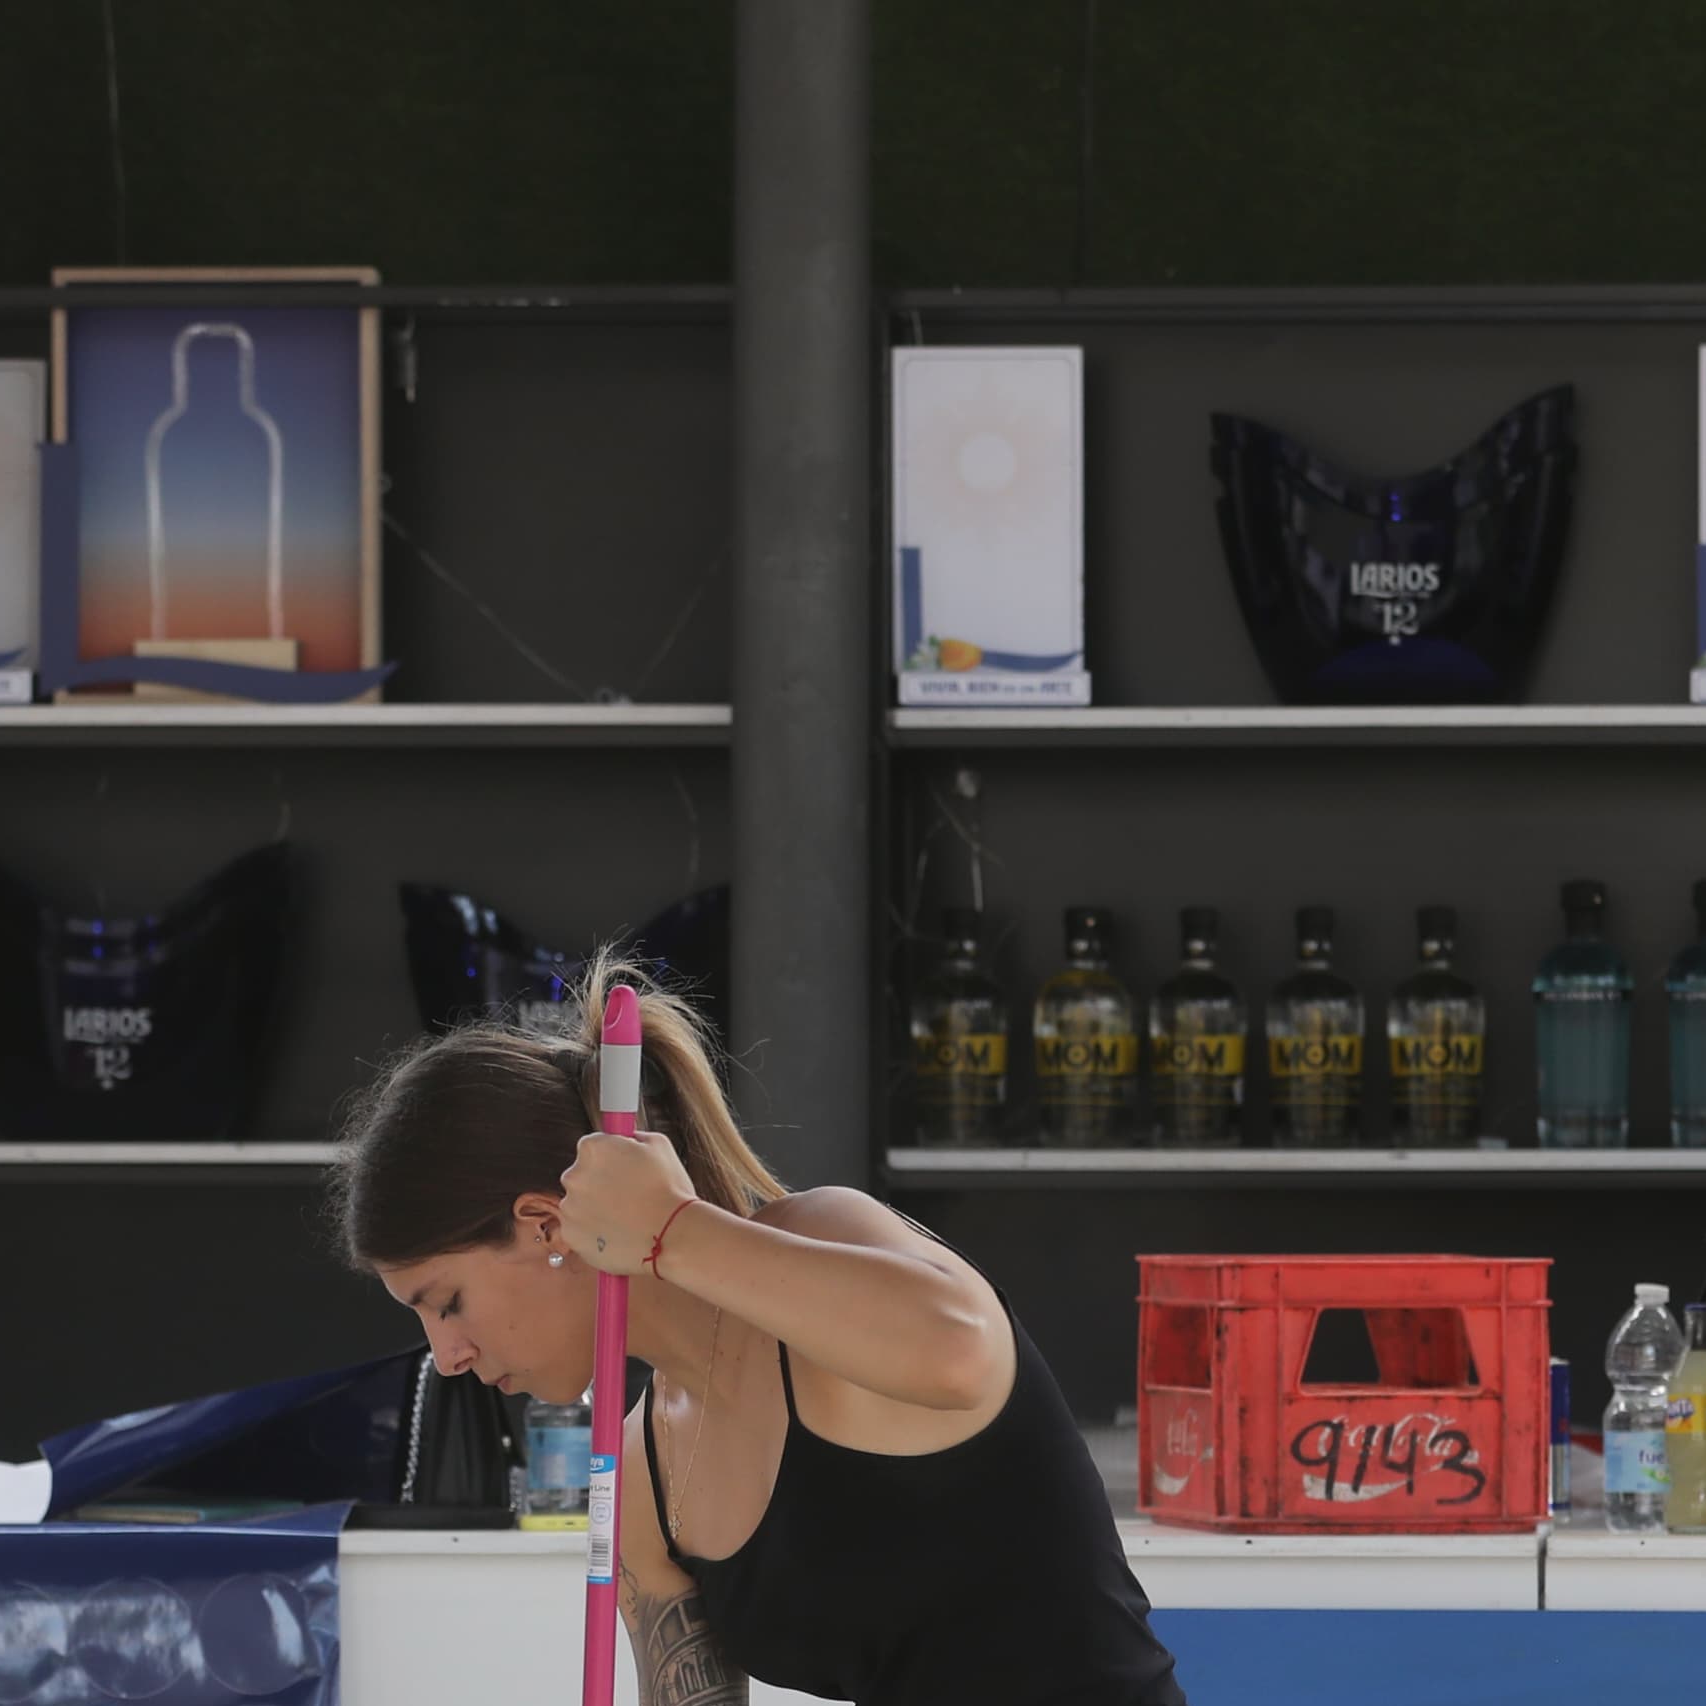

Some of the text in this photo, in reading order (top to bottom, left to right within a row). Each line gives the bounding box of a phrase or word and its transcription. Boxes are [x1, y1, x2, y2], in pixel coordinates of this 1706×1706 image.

[1351, 562, 1441, 598] LARIOS
[1379, 600, 1420, 636] 12
[64, 1006, 153, 1043] LARIOS
[1039, 1042, 1119, 1069] MOM
[1275, 1042, 1354, 1069] MOM
[1397, 1042, 1478, 1069] MOM
[1290, 1419, 1487, 1506] 9143
